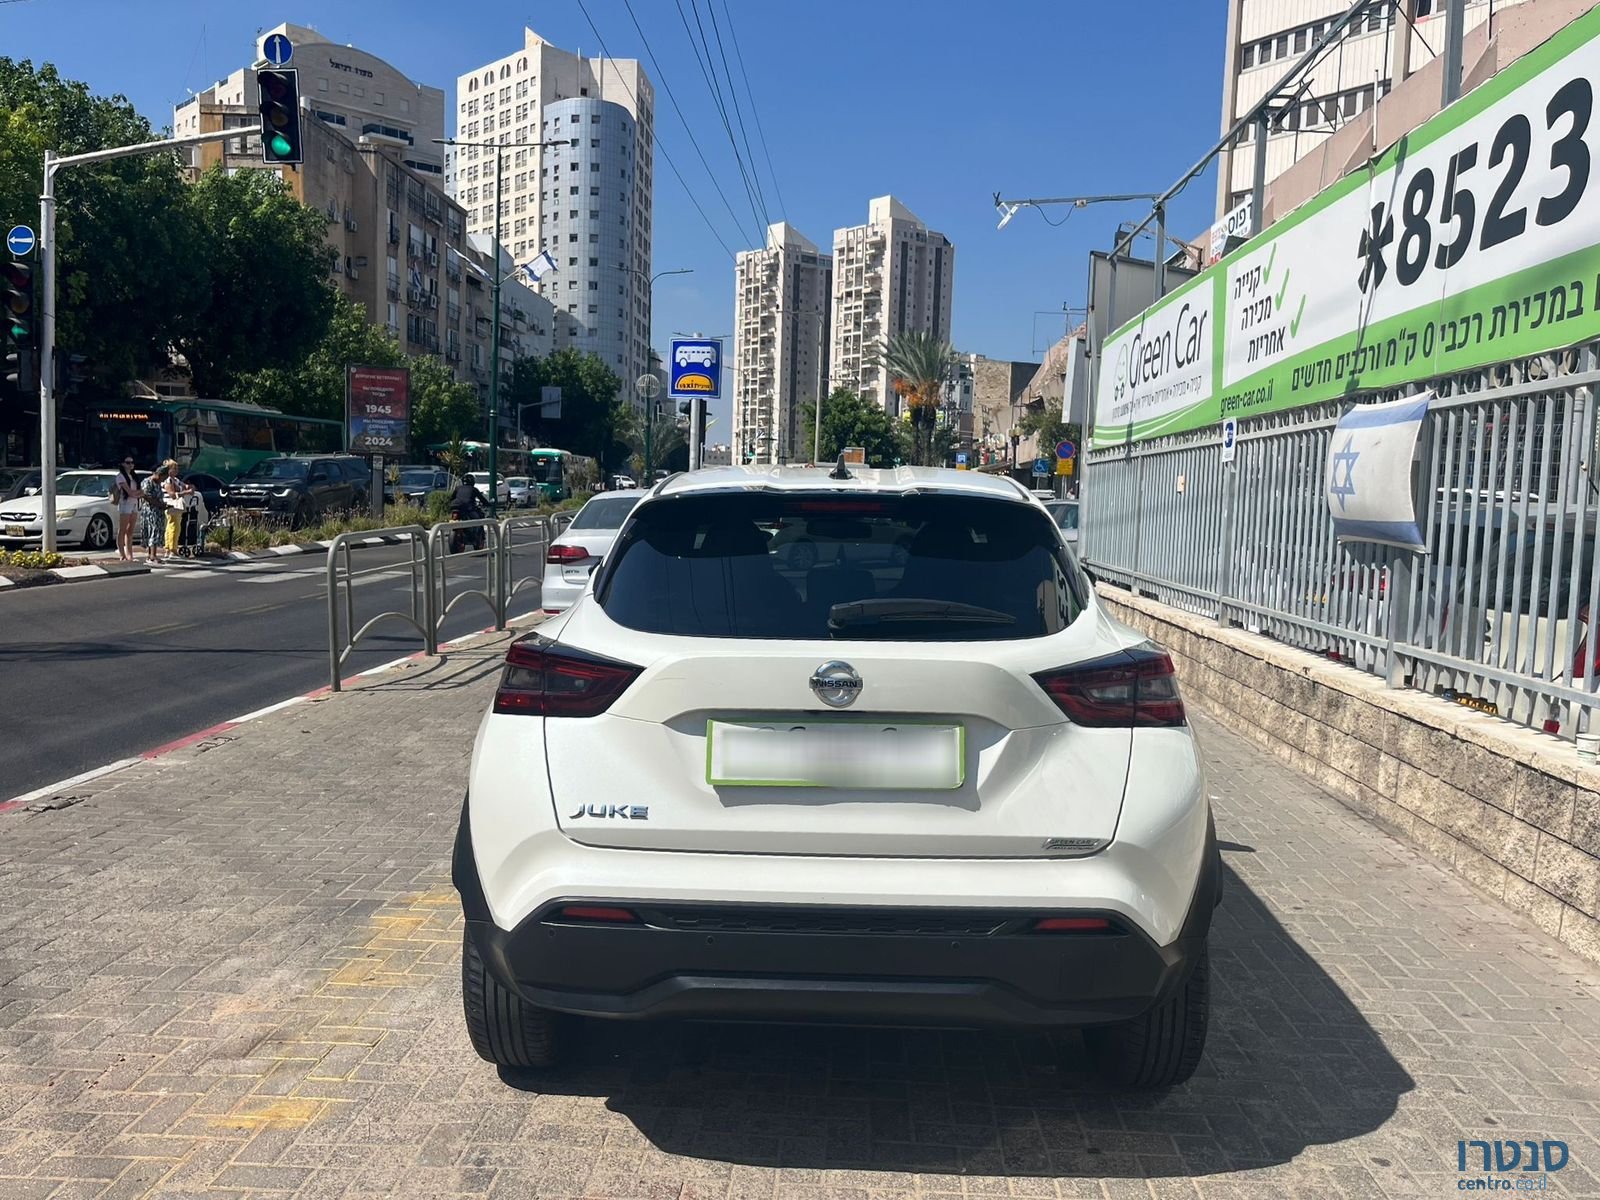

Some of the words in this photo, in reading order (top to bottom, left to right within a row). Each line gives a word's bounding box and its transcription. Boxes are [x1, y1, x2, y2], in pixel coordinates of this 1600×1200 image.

[1234, 265, 1261, 299] קנייה
[1241, 295, 1272, 330] מכירה
[1488, 280, 1584, 341] במכירת
[1129, 330, 1171, 388] Green
[1174, 303, 1207, 368] Car
[1247, 326, 1285, 363] אחריות
[1423, 321, 1435, 358] 0
[1440, 312, 1483, 352] רכבי
[1291, 358, 1332, 391] חדשים
[1335, 342, 1381, 380] ורכבים
[365, 404, 392, 413] 1945
[1220, 378, 1274, 418] green-car.co.il
[364, 437, 393, 447] 2024
[814, 679, 858, 688] NISSAN
[568, 803, 649, 821] JUKE
